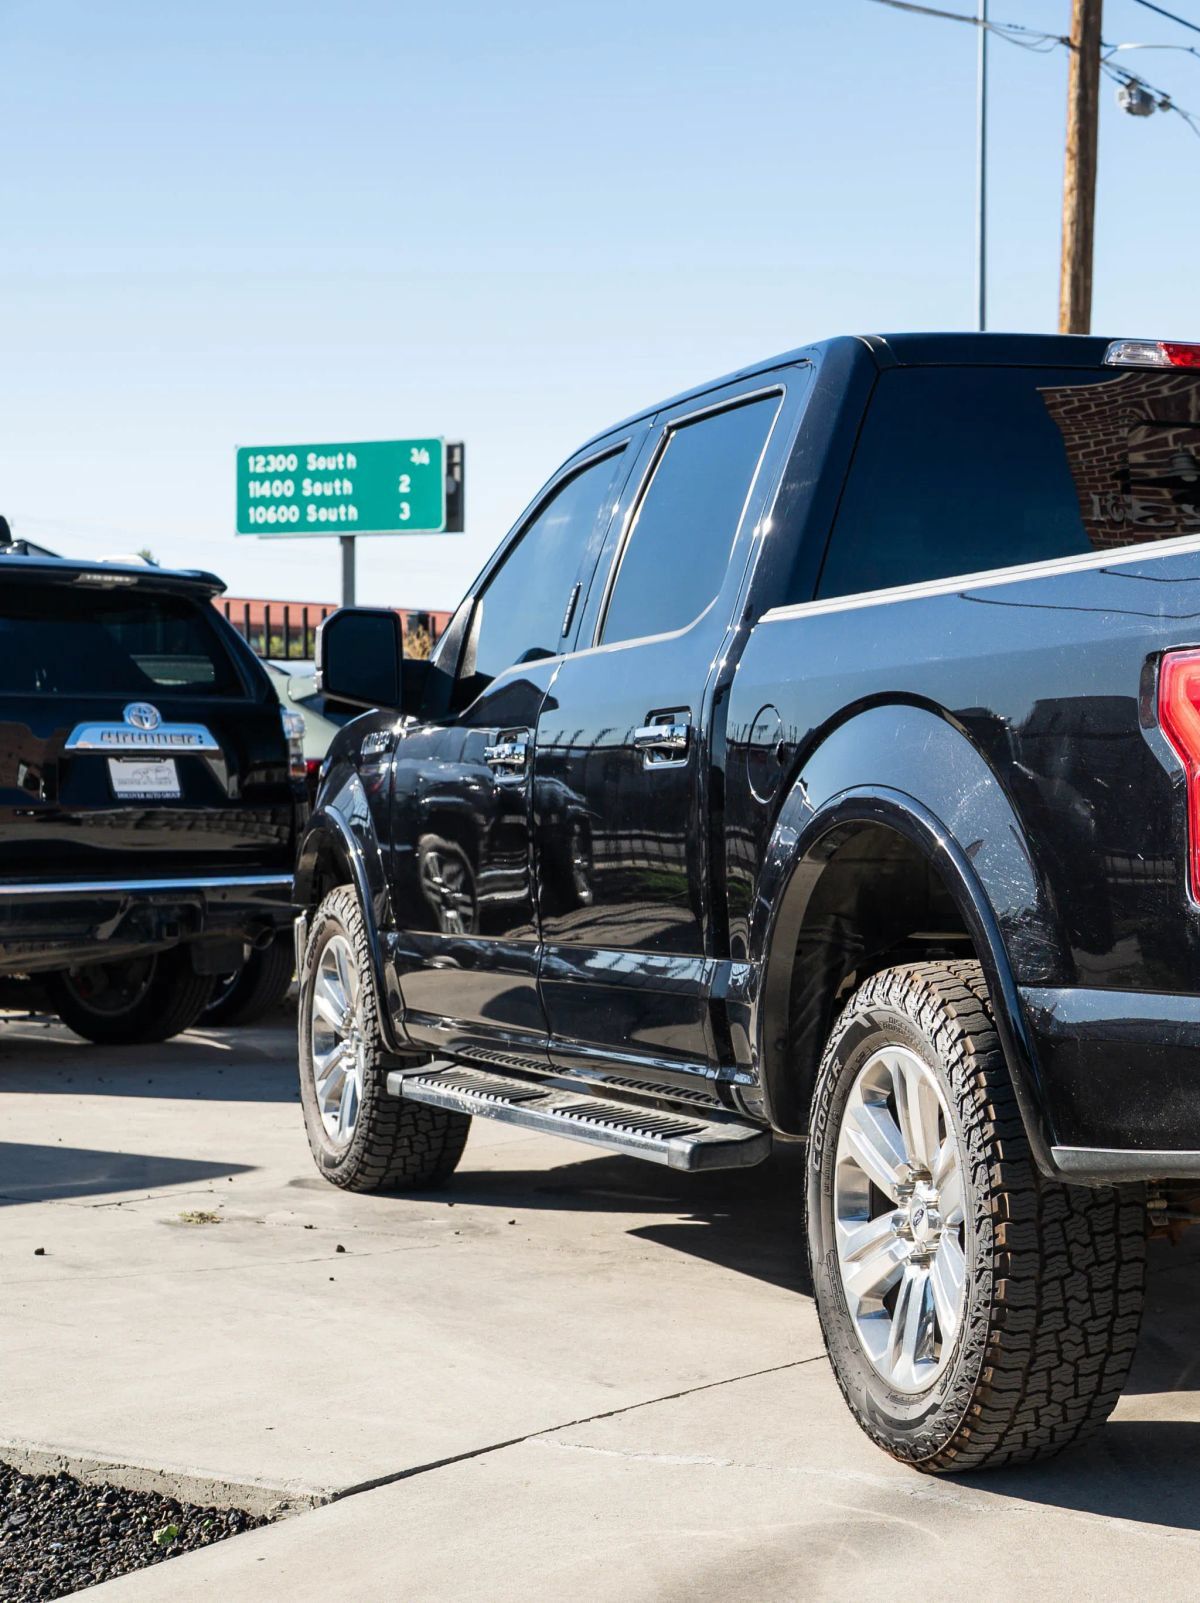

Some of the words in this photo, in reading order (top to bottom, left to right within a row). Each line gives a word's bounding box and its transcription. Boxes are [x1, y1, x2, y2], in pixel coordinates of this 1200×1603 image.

[248, 453, 298, 473] 12300
[306, 453, 357, 470] South
[248, 479, 295, 498] 11400
[302, 478, 353, 497] South
[399, 474, 411, 493] 2
[248, 505, 300, 524] 10600
[306, 504, 358, 522] South
[399, 502, 411, 520] 3
[812, 1057, 843, 1171] COOPER
